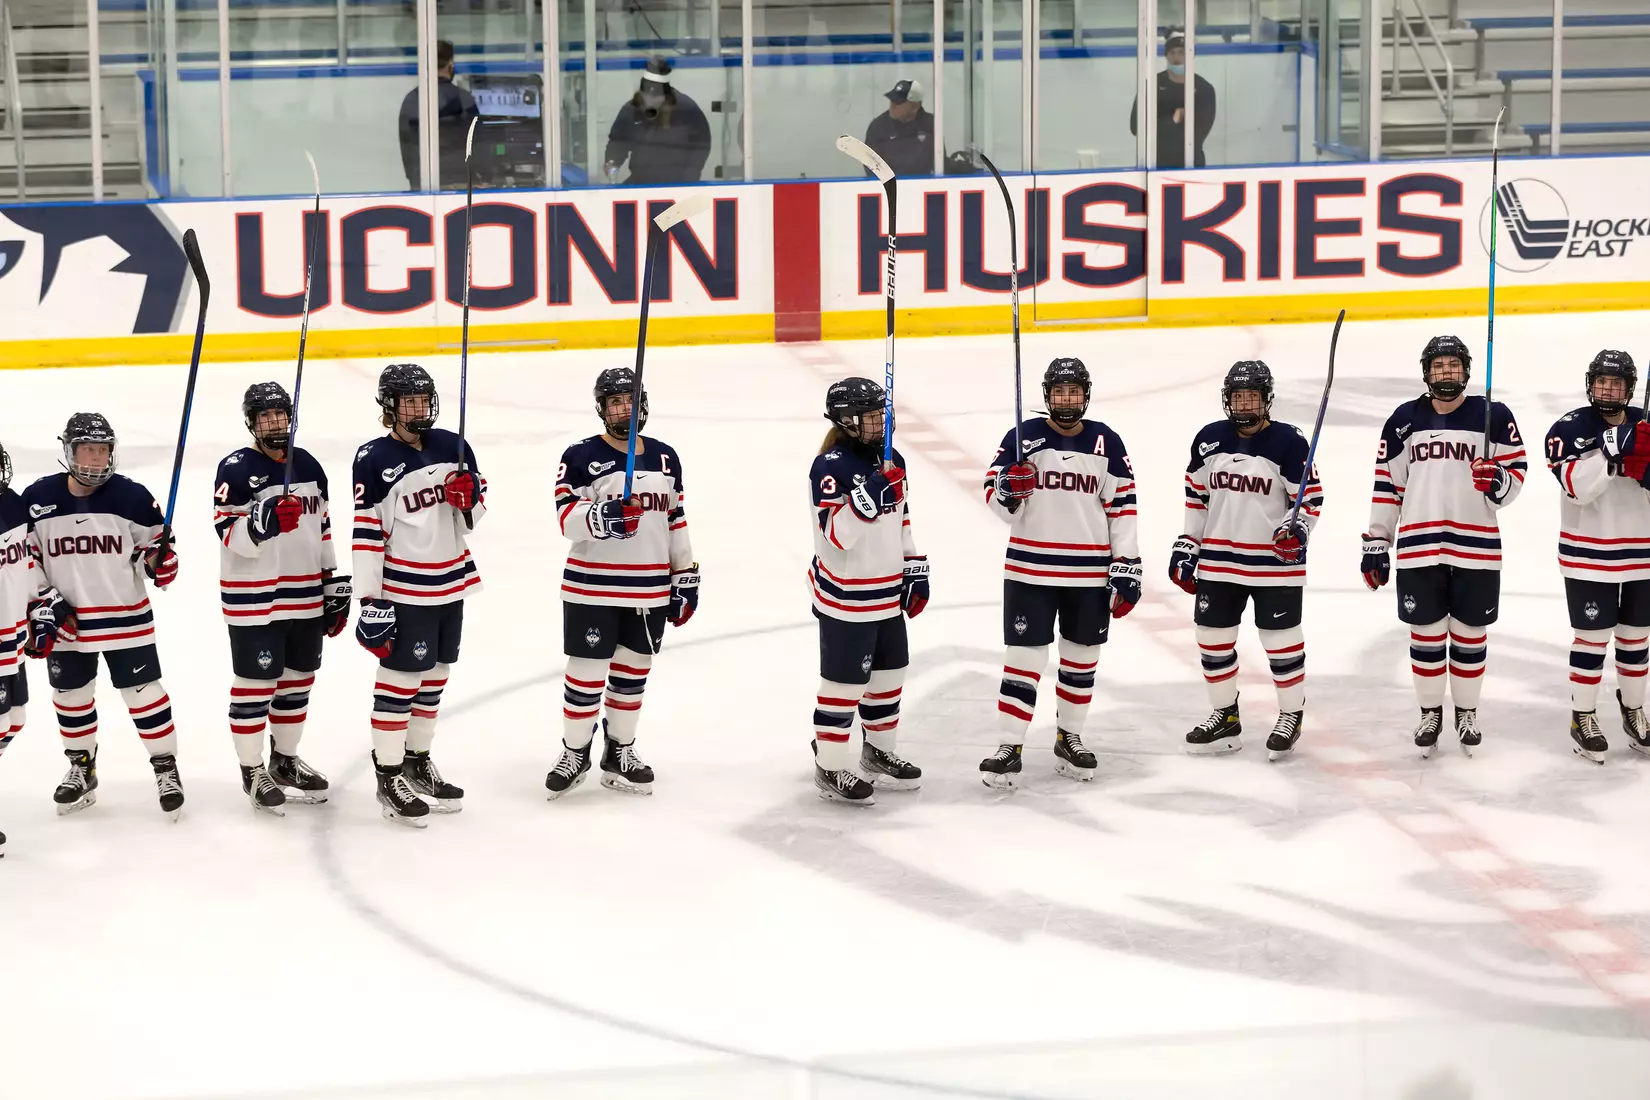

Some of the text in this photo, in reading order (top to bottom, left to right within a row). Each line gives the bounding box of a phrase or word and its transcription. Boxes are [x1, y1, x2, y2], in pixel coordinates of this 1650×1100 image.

[1572, 218, 1650, 238] HOCK
[235, 198, 739, 318] UCONN
[857, 173, 1464, 295] HUSKIES
[1566, 238, 1634, 259] EAST
[887, 234, 897, 300] BAUER
[1093, 434, 1106, 456] A
[660, 453, 671, 474] C
[214, 482, 230, 503] 4
[820, 474, 837, 495] 3
[1209, 470, 1273, 496] UCONN
[354, 483, 365, 505] 2
[402, 484, 447, 514] UCO
[47, 534, 124, 558] UCONN
[1111, 565, 1143, 576] BAUE
[361, 609, 396, 618] BAUE
